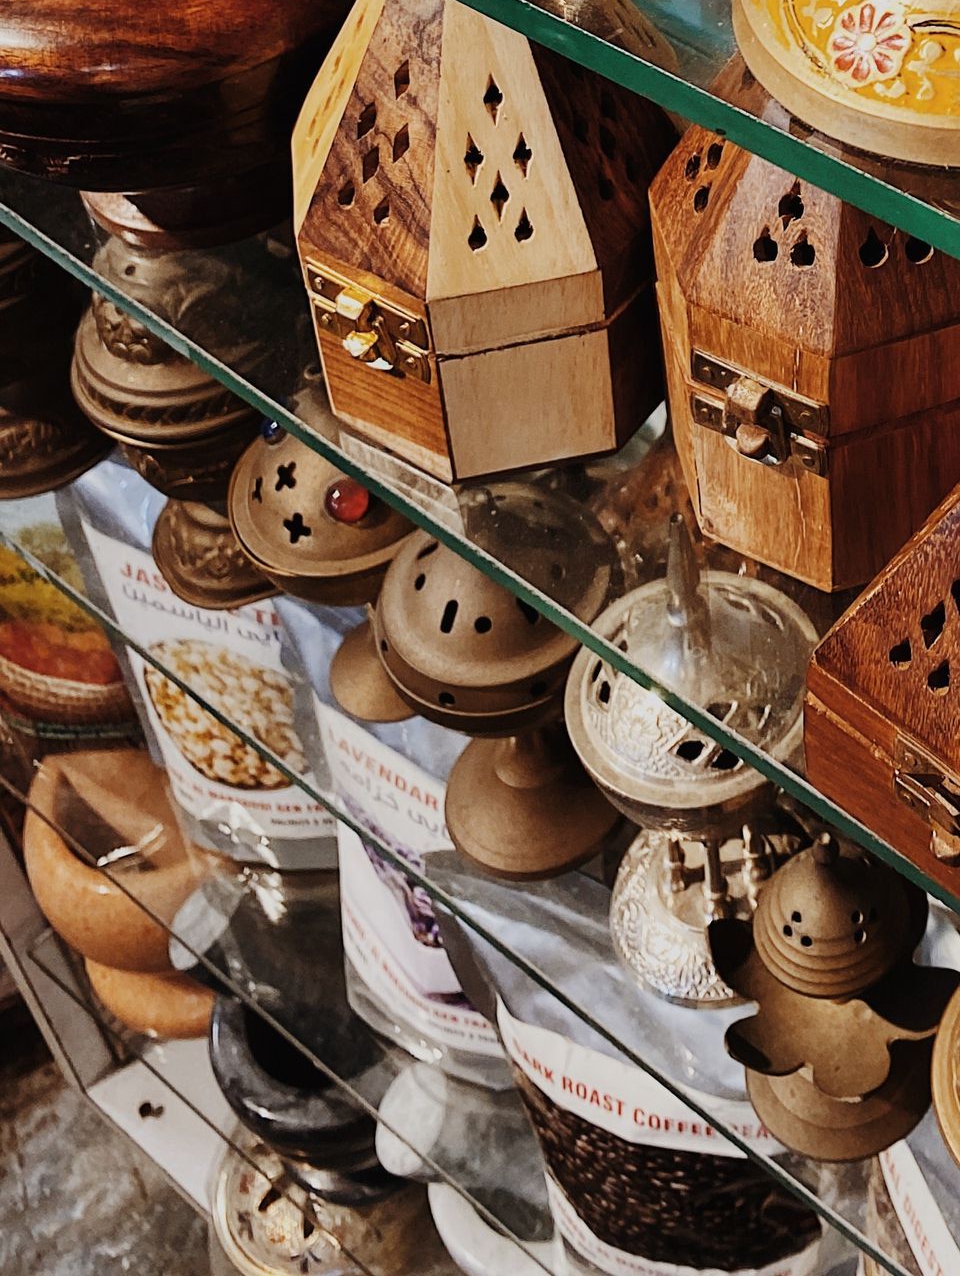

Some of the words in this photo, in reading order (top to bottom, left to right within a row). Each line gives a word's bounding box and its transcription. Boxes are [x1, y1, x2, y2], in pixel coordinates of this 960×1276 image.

[328, 725, 439, 812] LAVENDAR
[561, 1075, 627, 1118] ROAST
[632, 1107, 716, 1139] COFFEE
